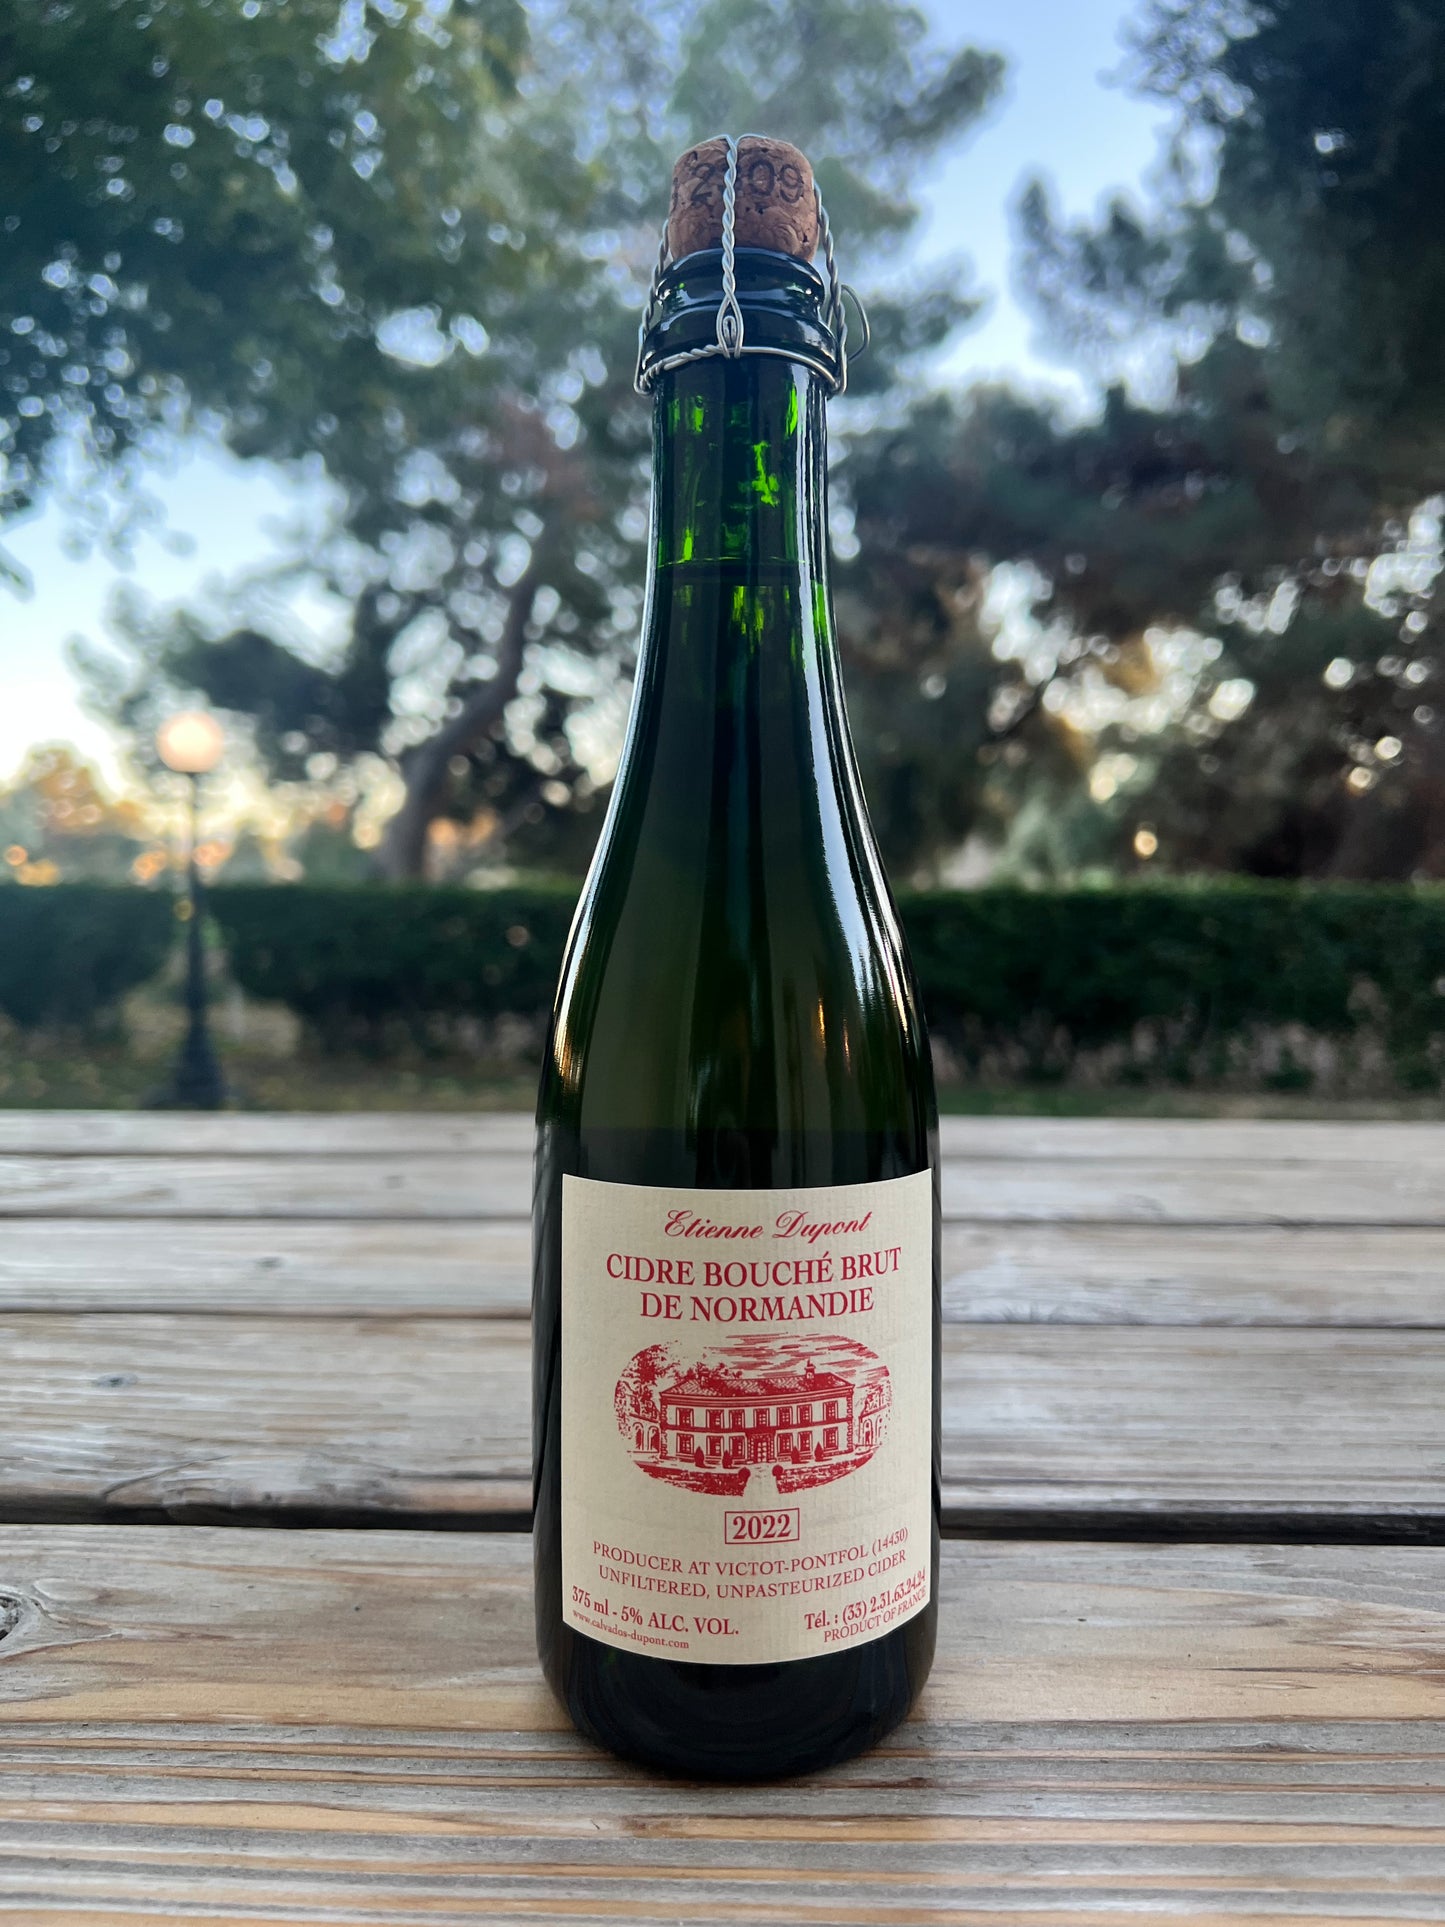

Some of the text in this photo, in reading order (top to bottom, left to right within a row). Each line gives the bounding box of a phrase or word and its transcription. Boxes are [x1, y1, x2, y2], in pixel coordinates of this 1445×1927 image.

[664, 1210, 872, 1244] Etienne Dupont
[606, 1247, 902, 1288] CIDRE BOUCHÉ BRUT
[640, 1287, 874, 1322] DE NORMANDIE
[733, 1513, 791, 1540] 2022
[593, 1526, 908, 1577] PRODUCER AT VICTOT-PONTFOL (14430)
[599, 1549, 906, 1599] UNFILTERED, UNPASTEURIZED CIDER
[572, 1585, 591, 1608] 375
[593, 1599, 609, 1616] ml
[621, 1606, 643, 1625] 5%
[647, 1612, 689, 1633] ALC.
[693, 1616, 739, 1635] VOL.
[572, 1610, 690, 1649] www.calvados-dupont.com
[804, 1610, 831, 1630] Tél.
[842, 1600, 867, 1625] (33)
[823, 1585, 926, 1643] PRODUCT OF FRANCE
